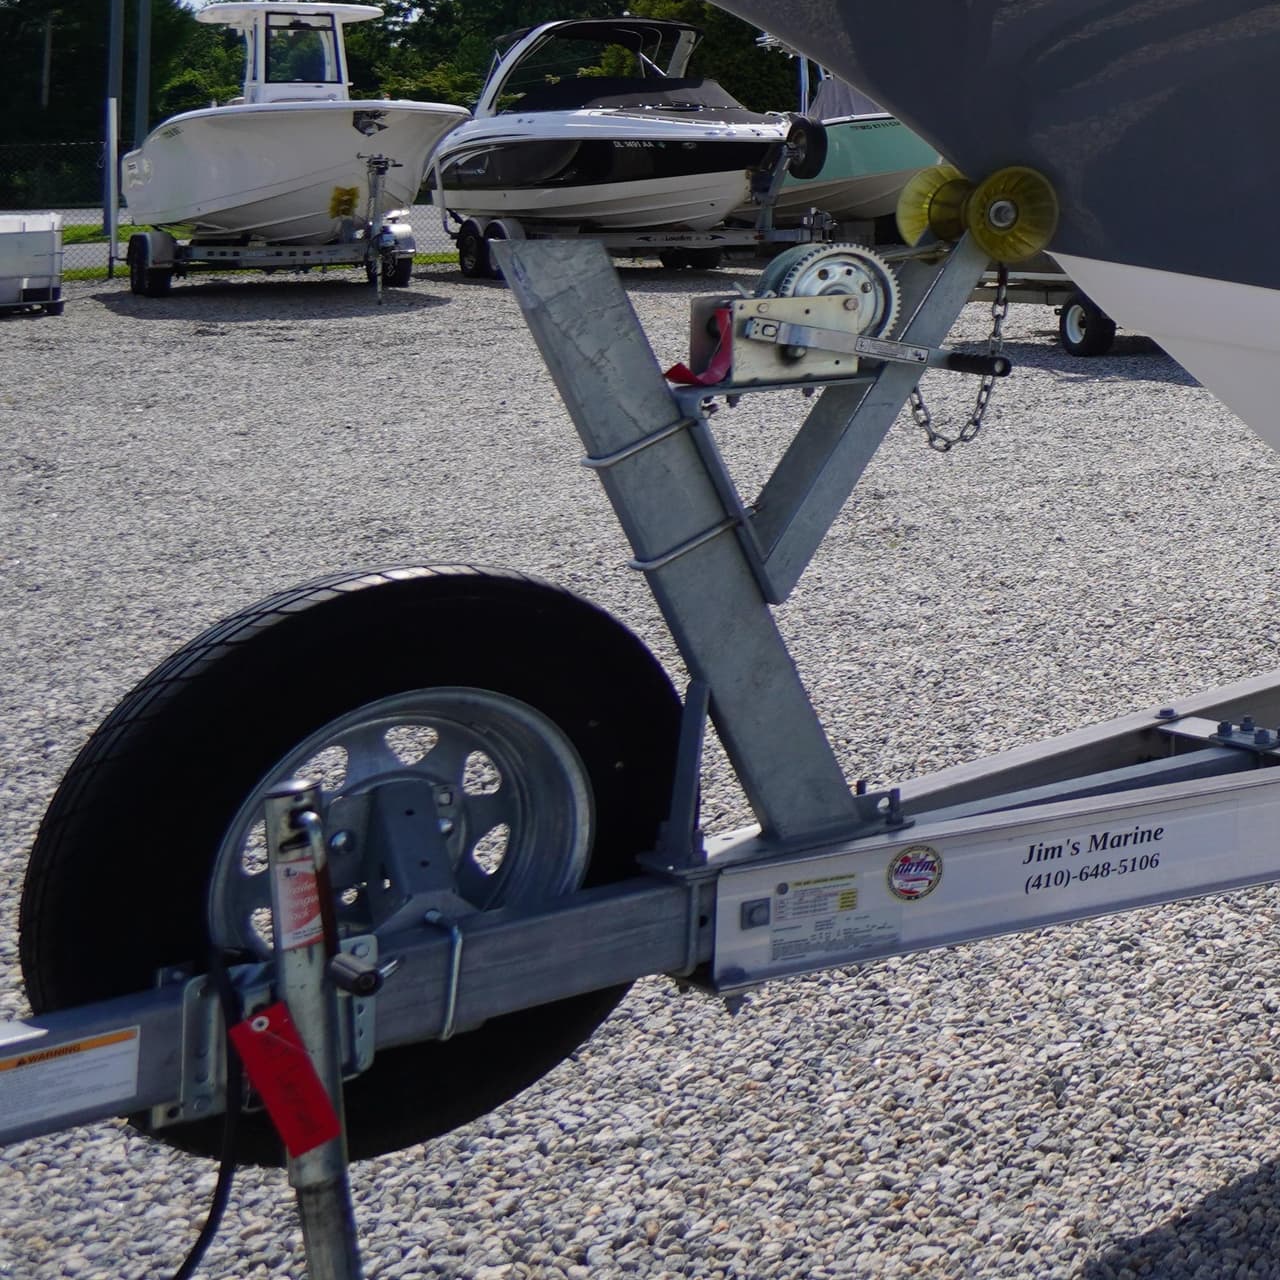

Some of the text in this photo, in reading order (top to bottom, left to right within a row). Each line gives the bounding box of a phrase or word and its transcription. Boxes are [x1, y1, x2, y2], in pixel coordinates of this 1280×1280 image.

[1022, 826, 1164, 865] Jim's Marine
[1025, 852, 1161, 894] (410)-648-5106
[28, 1043, 81, 1063] WARNING
